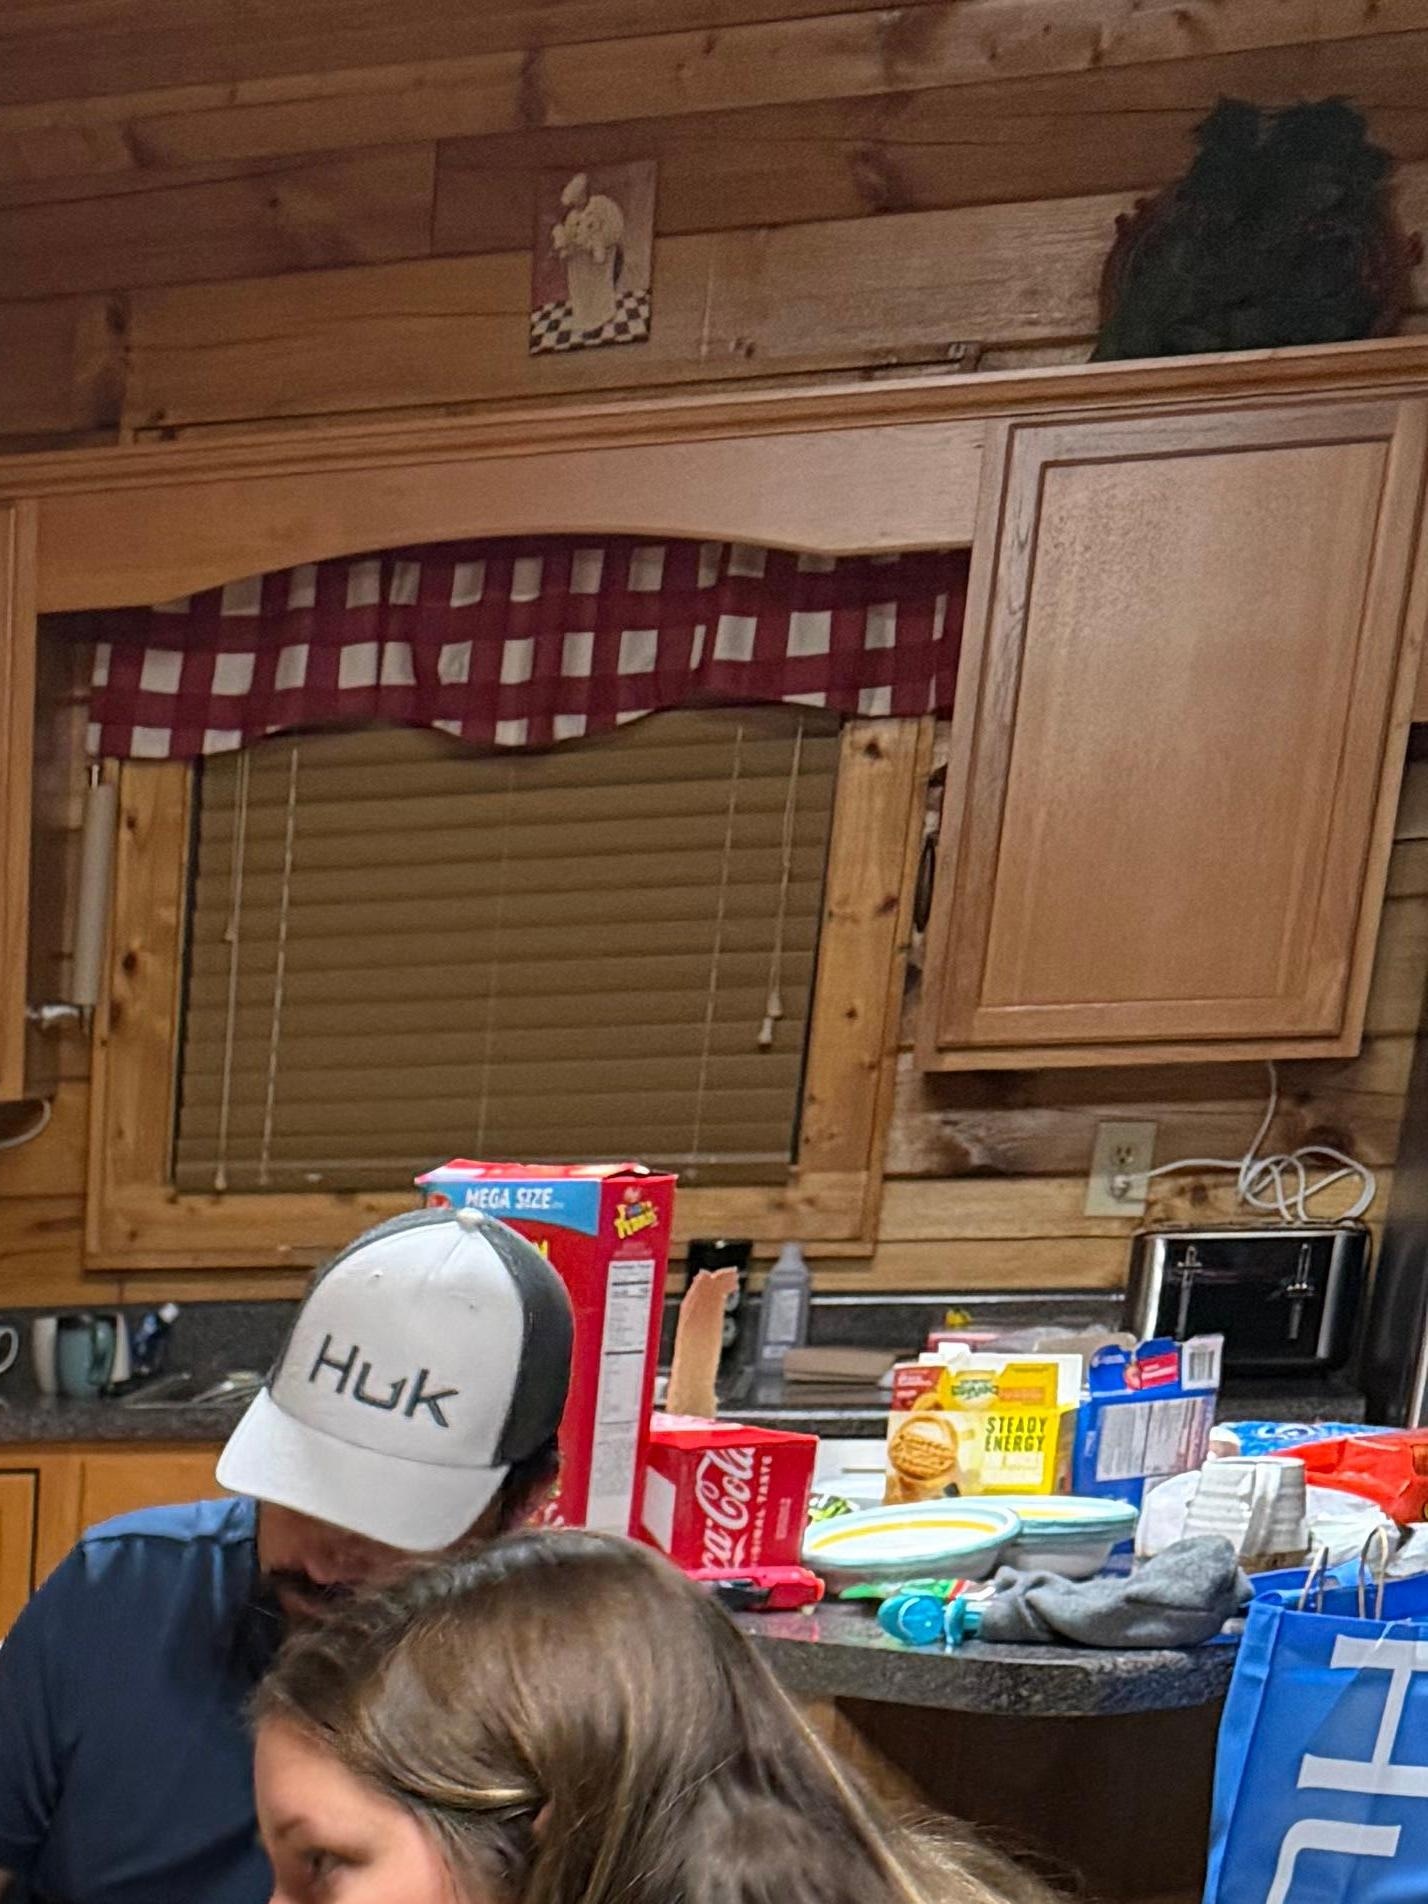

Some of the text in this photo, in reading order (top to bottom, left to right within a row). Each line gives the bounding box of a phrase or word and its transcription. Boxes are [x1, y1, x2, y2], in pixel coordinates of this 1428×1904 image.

[465, 1187, 553, 1209] MEGA SIZE
[984, 1416, 1048, 1434] STEADY
[984, 1434, 1046, 1452] ENERGY
